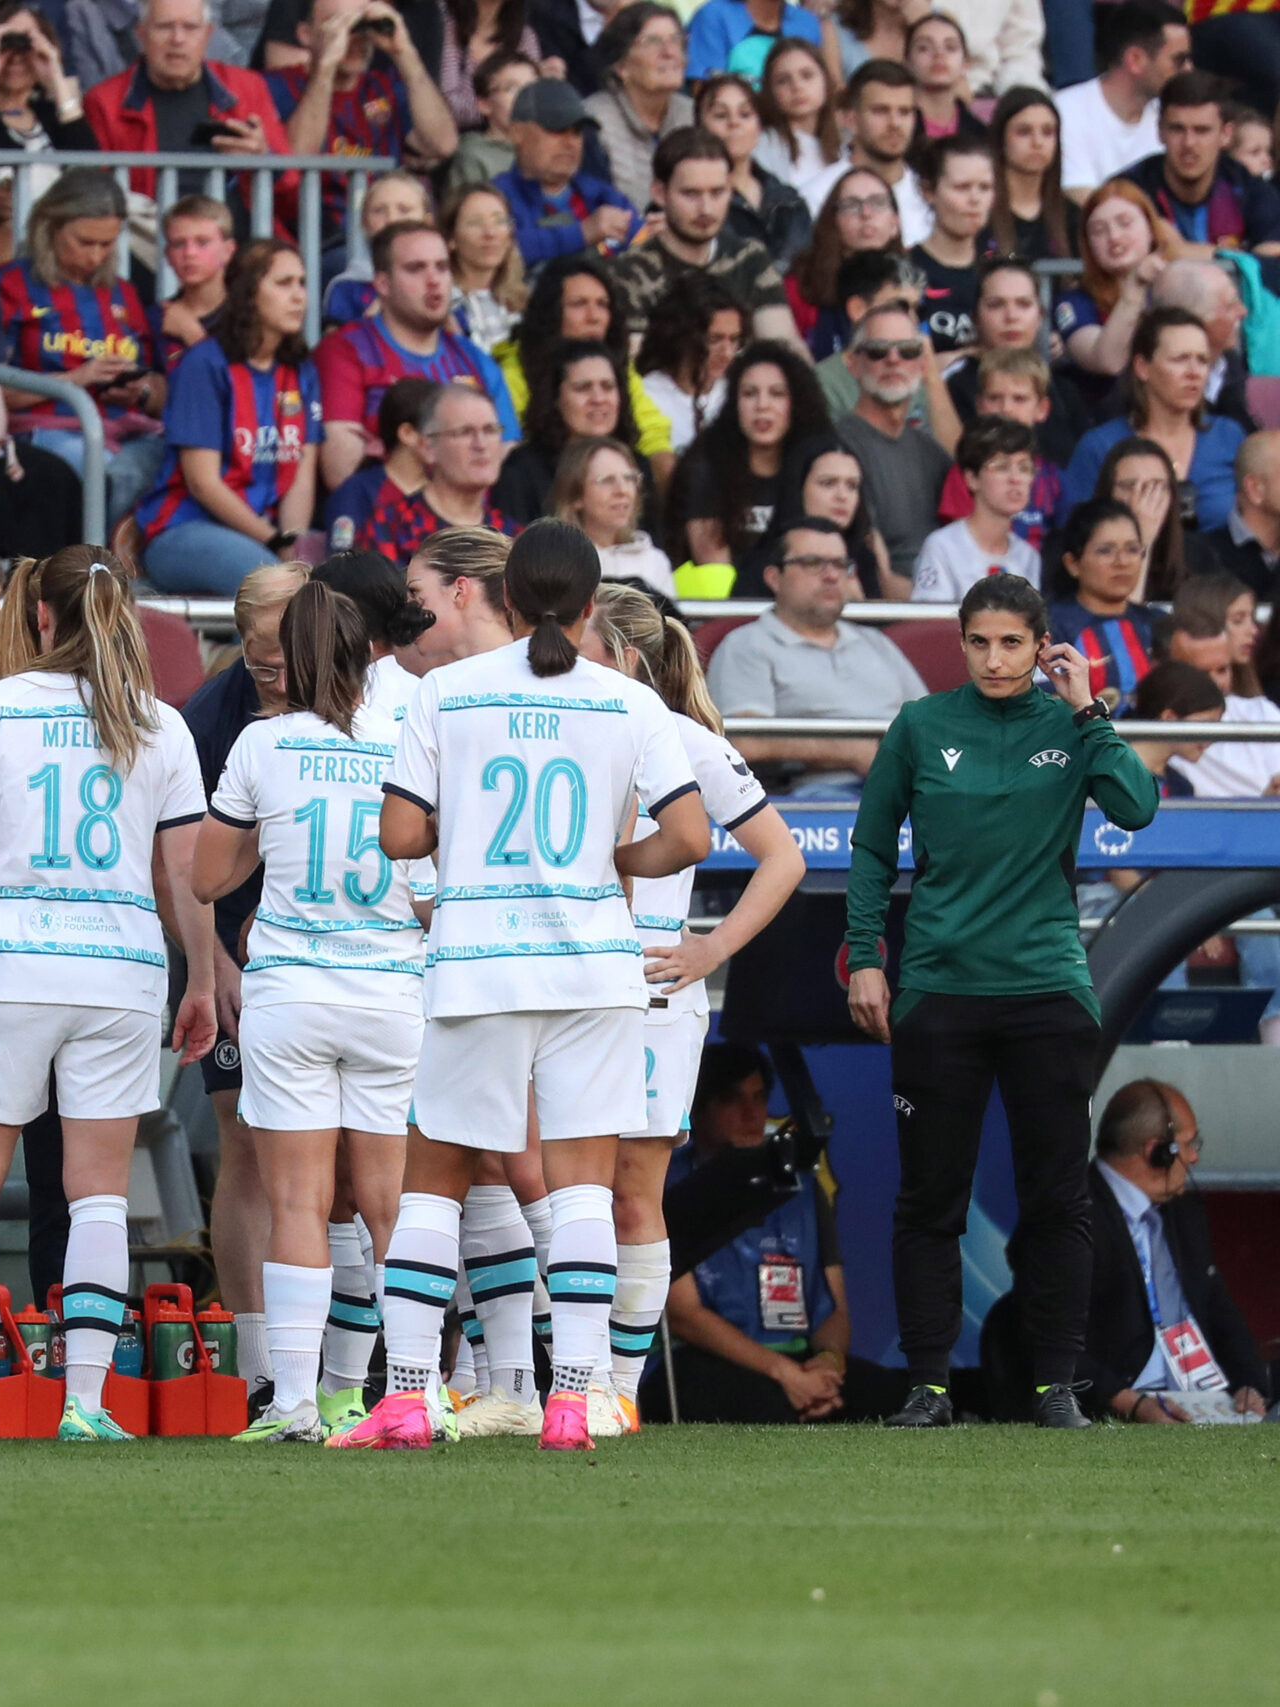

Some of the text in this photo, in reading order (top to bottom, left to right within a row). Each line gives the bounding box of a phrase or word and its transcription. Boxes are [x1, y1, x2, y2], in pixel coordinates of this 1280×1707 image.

[234, 425, 301, 456] QATAR
[509, 711, 560, 740] KERR
[1031, 752, 1067, 767] UEFA
[299, 755, 392, 786] PERISSE
[27, 762, 122, 872] 18
[481, 755, 588, 868] 20
[293, 796, 393, 908] 15
[64, 915, 104, 923] CHELSEA
[532, 912, 567, 920] CHELSEA
[64, 923, 120, 932] FOUNDATION
[332, 948, 389, 957] FOUNDATION
[429, 1281, 456, 1294] CFC
[568, 1277, 605, 1287] CFC
[72, 1299, 107, 1311] CFC
[27, 1342, 47, 1371] G
